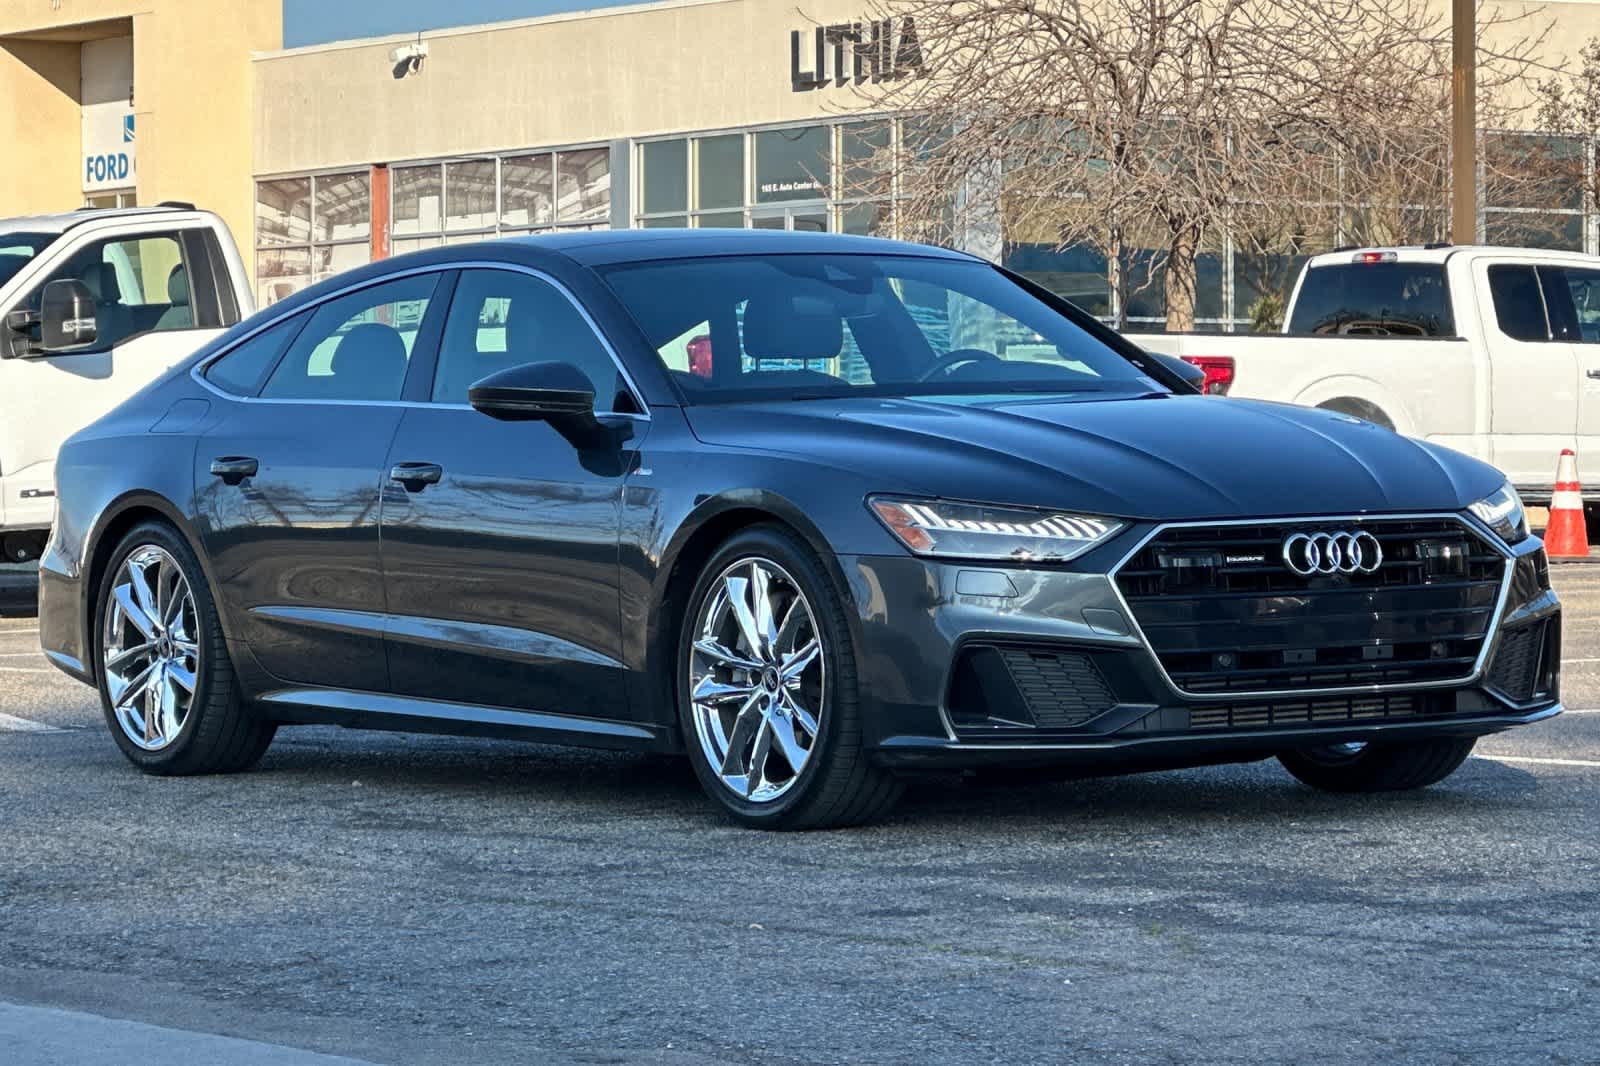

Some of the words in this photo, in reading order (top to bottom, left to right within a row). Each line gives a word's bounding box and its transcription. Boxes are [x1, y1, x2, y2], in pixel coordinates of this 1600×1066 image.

[791, 17, 922, 92] LITHIA
[86, 152, 129, 183] FORD
[779, 183, 793, 191] Auto
[793, 181, 813, 190] Center
